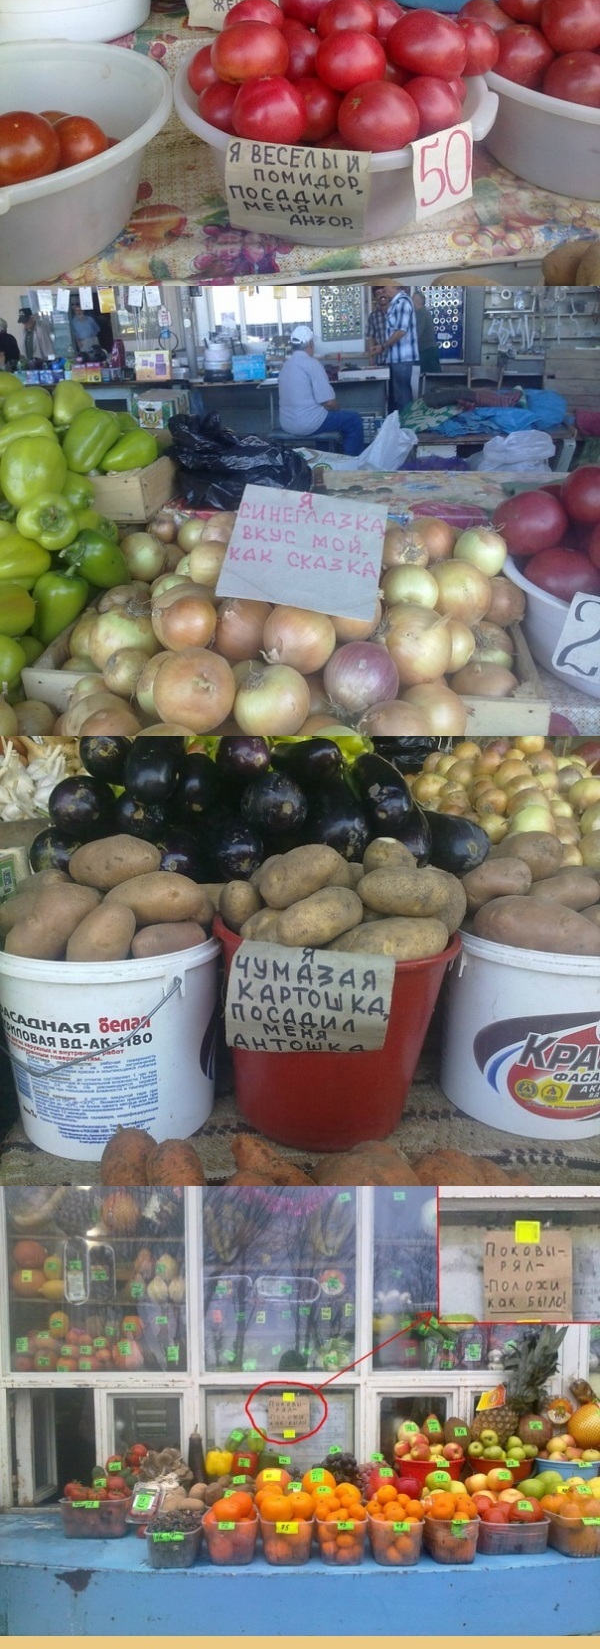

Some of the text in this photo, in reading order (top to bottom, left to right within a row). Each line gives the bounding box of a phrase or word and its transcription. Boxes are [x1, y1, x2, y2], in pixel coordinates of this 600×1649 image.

[229, 142, 241, 163] Я
[420, 129, 472, 208] 50
[228, 185, 343, 207] ПОСАДИЛ
[244, 201, 310, 213] МЕНЯ
[297, 493, 314, 510] Я
[242, 525, 296, 545] ВКУС
[229, 546, 378, 579] КАК СКАЗКА
[301, 947, 317, 964] Я
[235, 954, 377, 992] ЧУМАЗАЯ
[231, 1003, 356, 1033] ПОСАДИЛ
[263, 1023, 328, 1041] МЕНЯ
[233, 1033, 365, 1052] АНТОШКА
